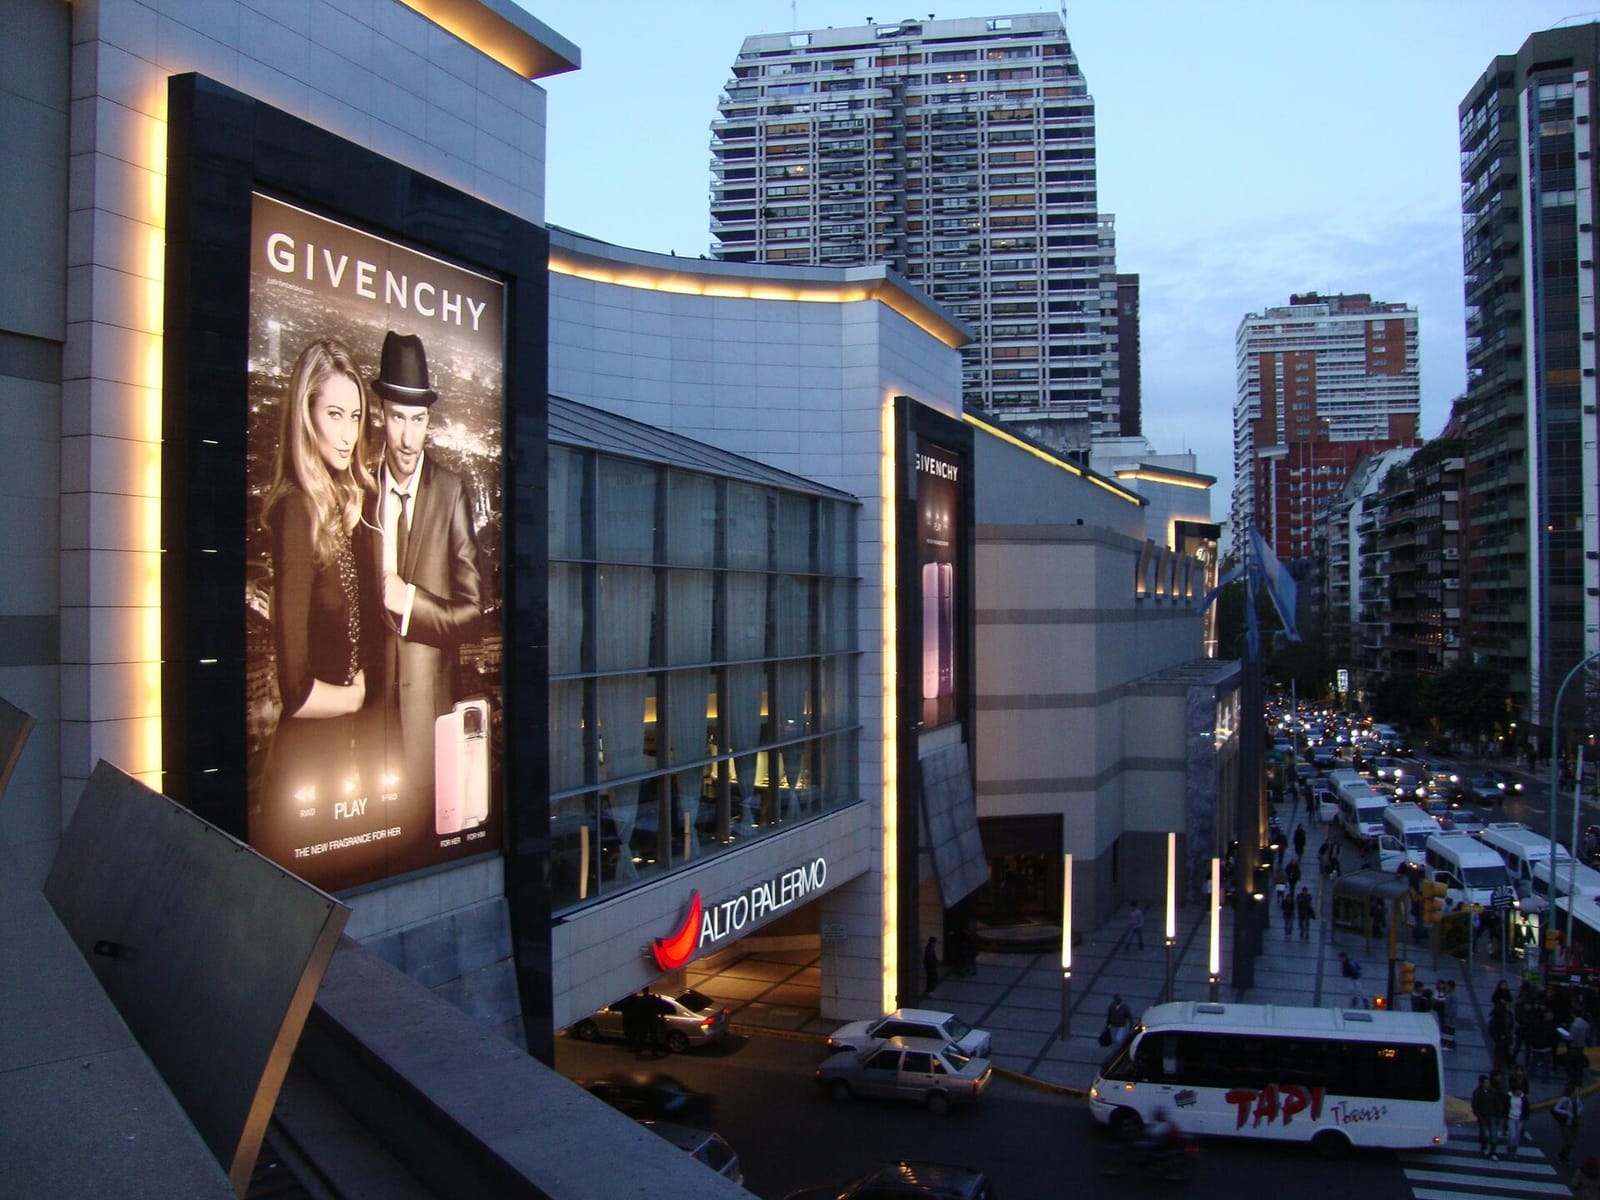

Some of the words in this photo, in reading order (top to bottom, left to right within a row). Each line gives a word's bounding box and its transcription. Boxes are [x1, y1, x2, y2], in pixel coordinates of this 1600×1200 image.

[266, 232, 486, 331] GIVENCHY
[334, 797, 368, 820] PLAY
[294, 847, 310, 858] THE
[311, 843, 329, 855] NEW
[329, 832, 372, 850] FRAGRANCE
[372, 830, 387, 841] FOR
[387, 826, 402, 837] HER
[699, 895, 749, 949] ALTO
[751, 857, 827, 921] PALERMO
[1225, 1083, 1326, 1131] TAPI
